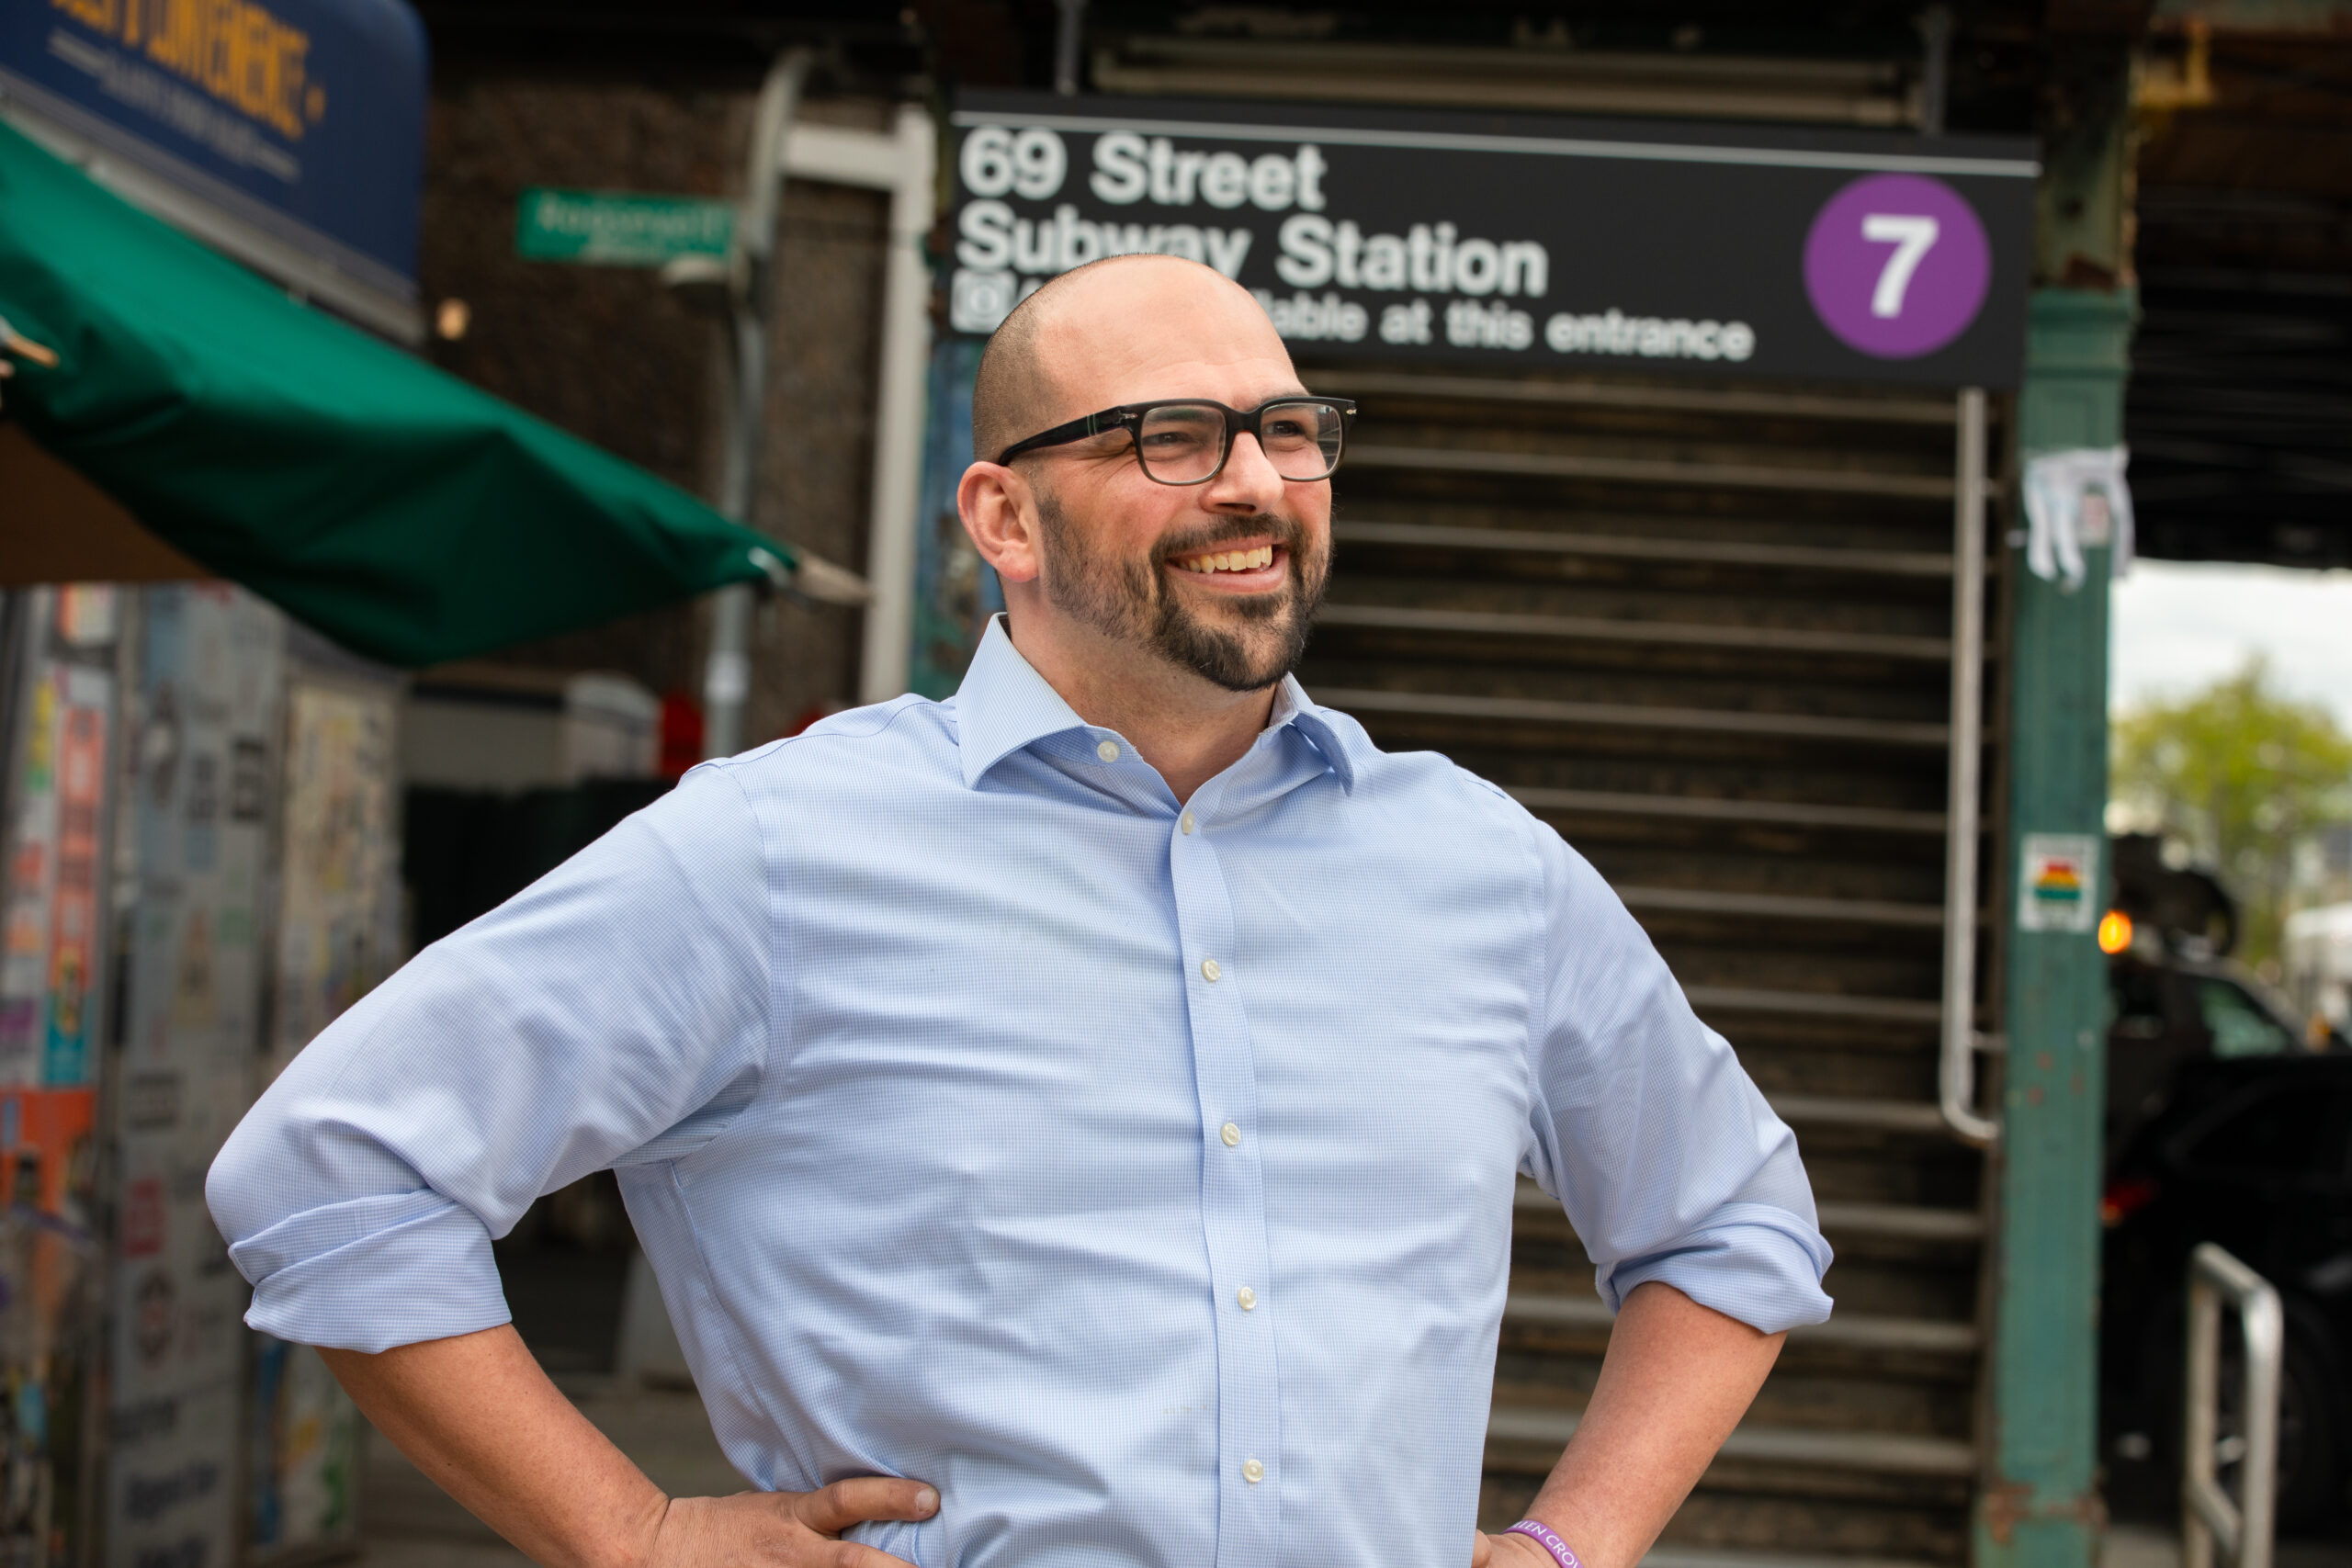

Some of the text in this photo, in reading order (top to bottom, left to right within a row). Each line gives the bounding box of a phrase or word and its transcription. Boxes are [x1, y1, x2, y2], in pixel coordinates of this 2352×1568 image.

[959, 127, 1327, 210] 69 Street
[1276, 214, 1549, 297] Station
[1862, 213, 1939, 319] 7
[1380, 299, 1433, 345] at
[1445, 298, 1534, 351] this
[1546, 309, 1755, 361] entrance
[1545, 1534, 1580, 1568] CRO
